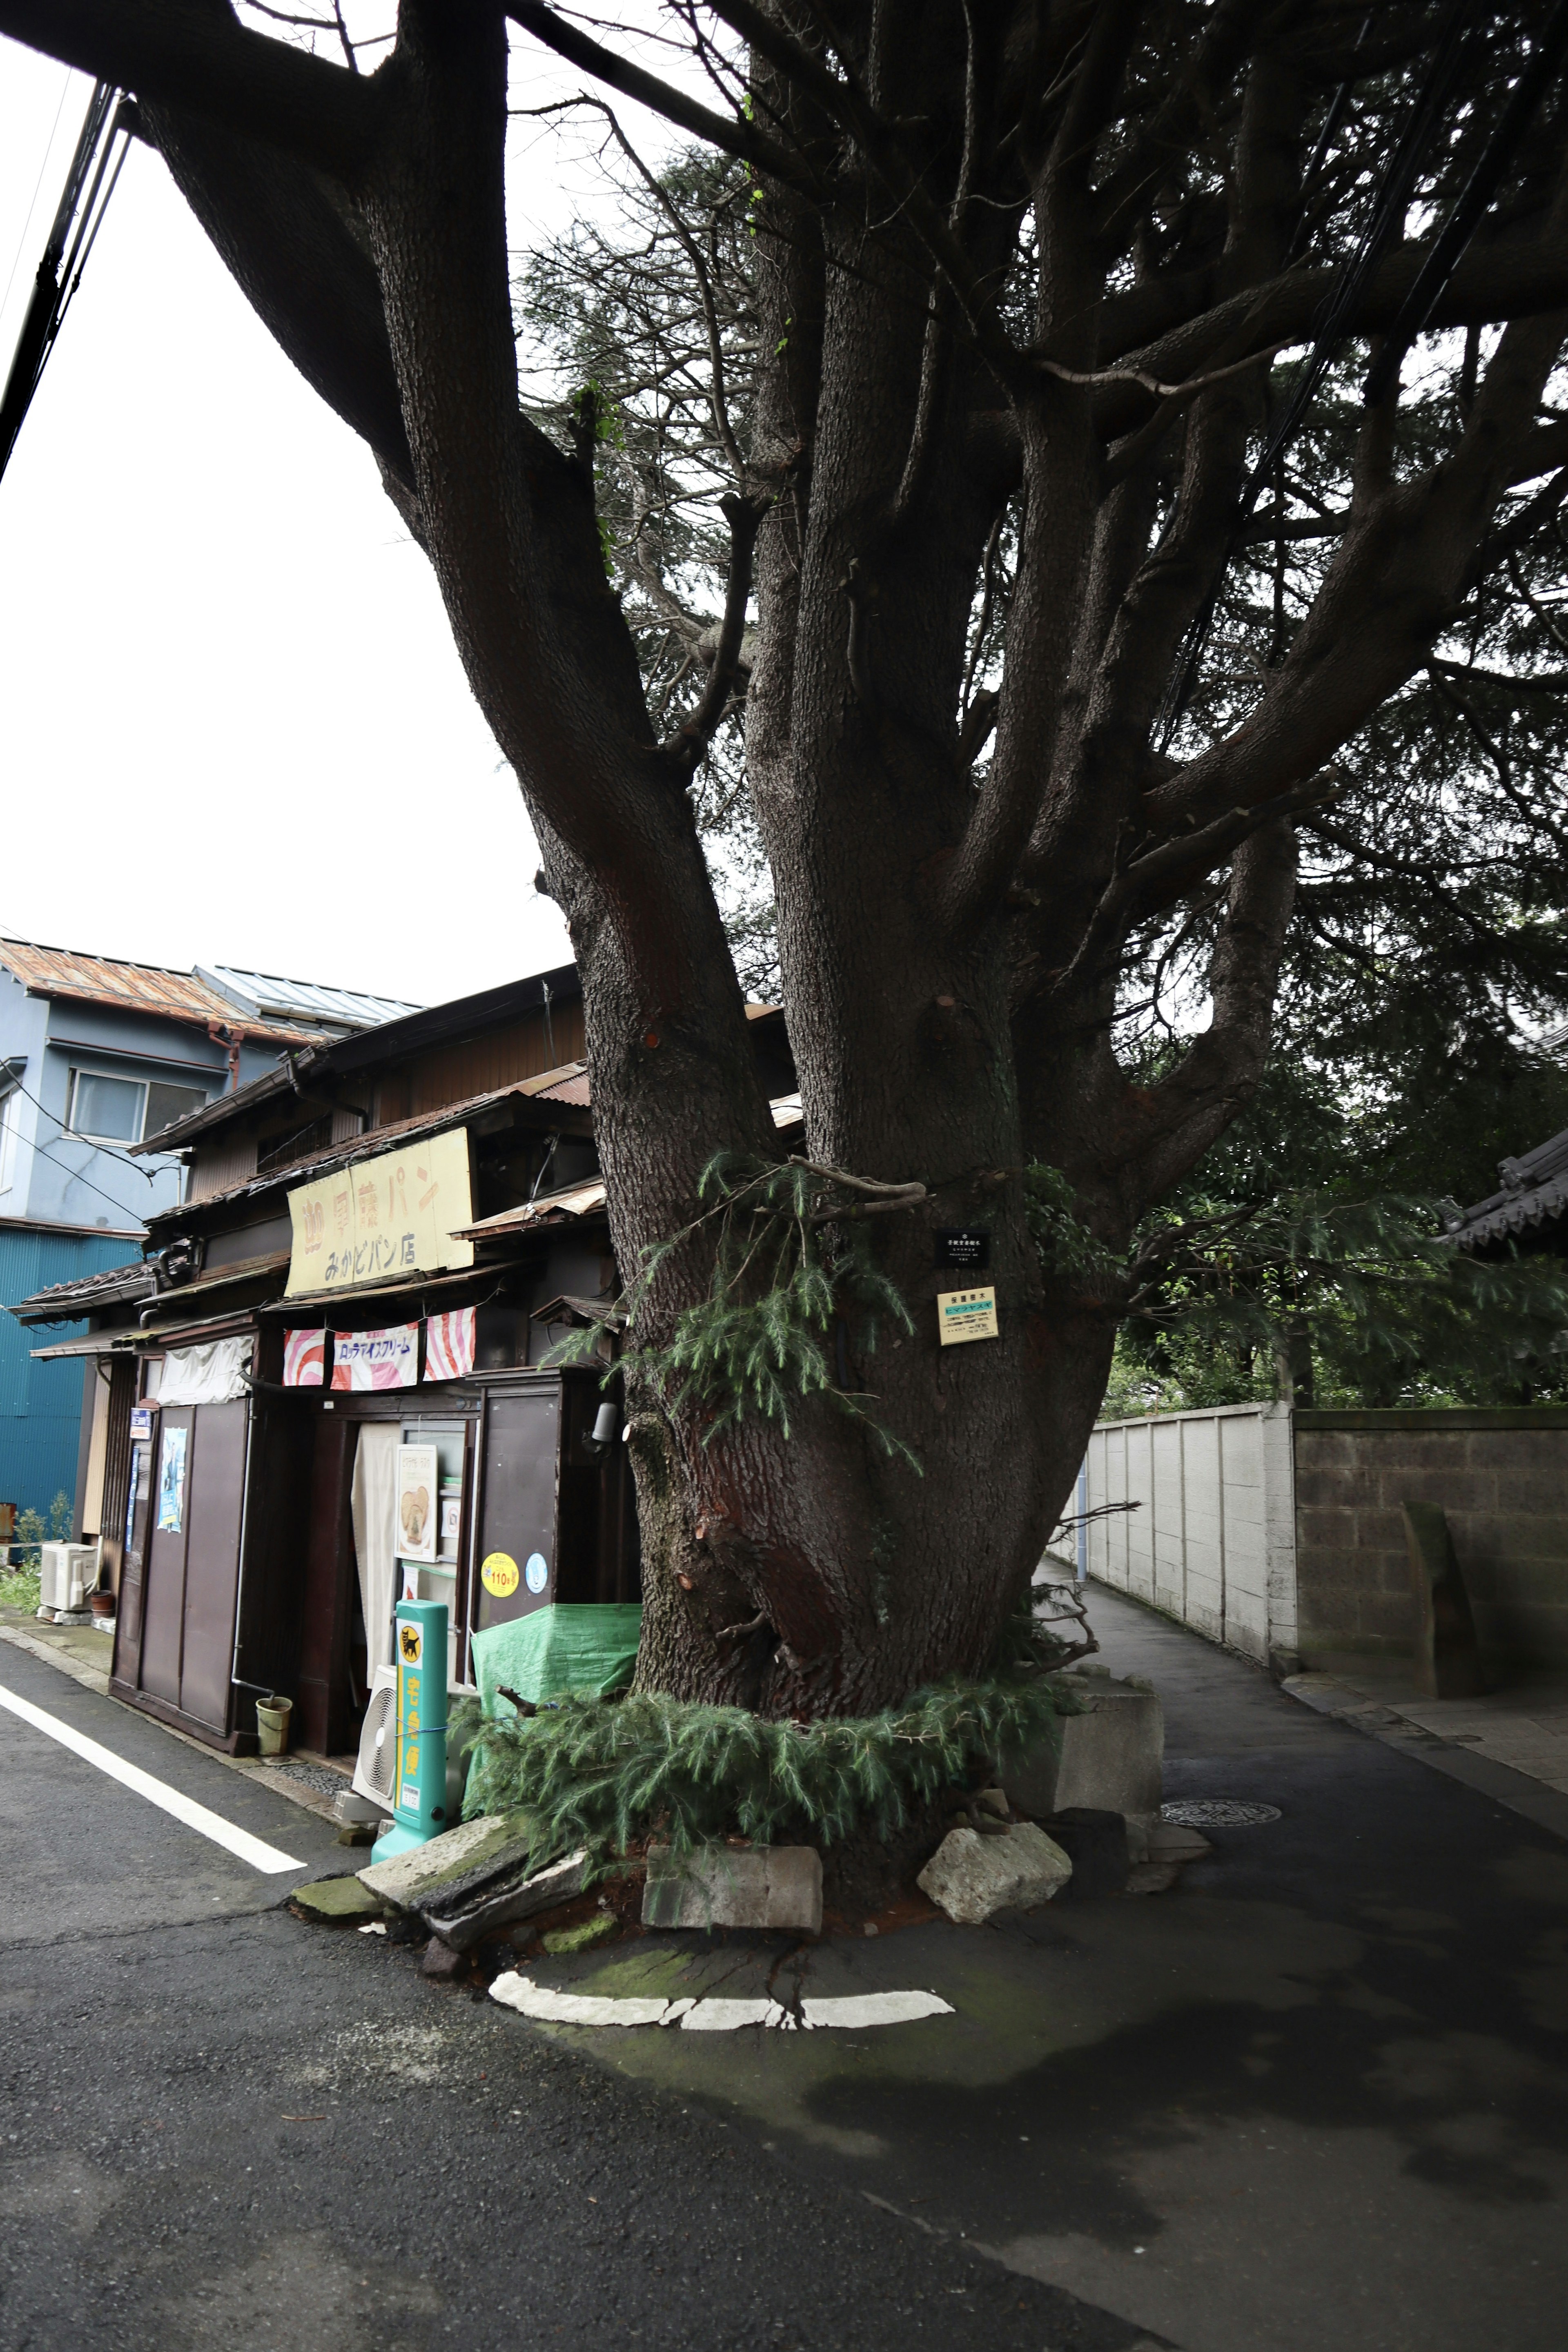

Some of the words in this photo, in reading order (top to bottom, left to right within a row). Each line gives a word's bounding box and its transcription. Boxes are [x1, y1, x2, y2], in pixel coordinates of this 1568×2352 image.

[333, 1166, 439, 1238] 伊藤パン
[325, 1232, 415, 1281] みかどパン店
[946, 1302, 992, 1314] ヒマラヤスギ
[405, 1676, 420, 1776] 宅急便
